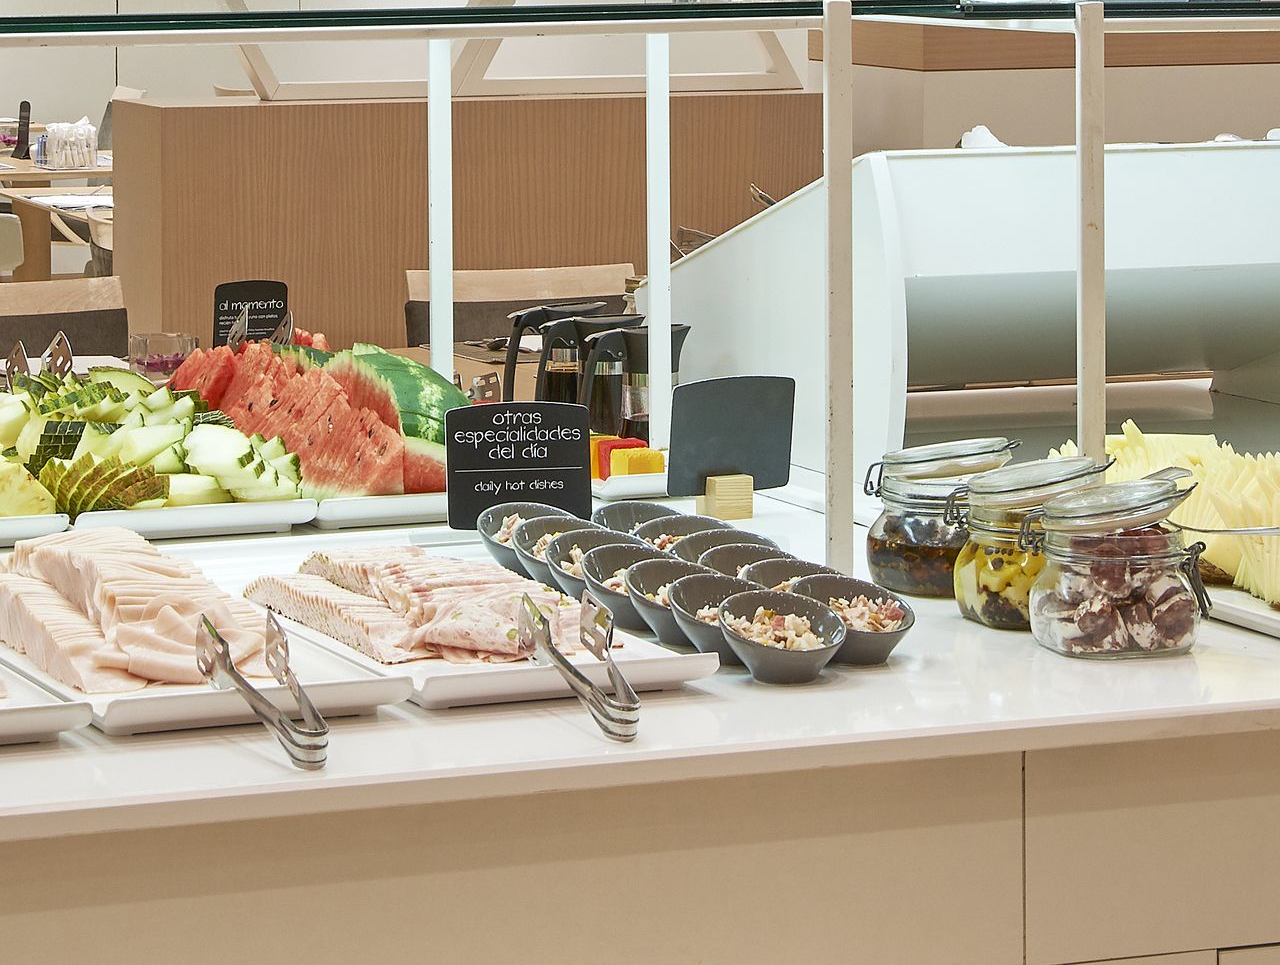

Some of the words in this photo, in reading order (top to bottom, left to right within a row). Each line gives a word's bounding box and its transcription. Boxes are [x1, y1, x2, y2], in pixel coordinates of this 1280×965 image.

[219, 300, 228, 311] al
[232, 299, 284, 311] momento
[492, 410, 542, 425] otras
[454, 425, 581, 449] especialidades
[488, 444, 515, 459] del
[522, 443, 548, 458] día
[474, 481, 501, 495] daily
[506, 481, 525, 491] hot
[529, 479, 564, 490] dishes
